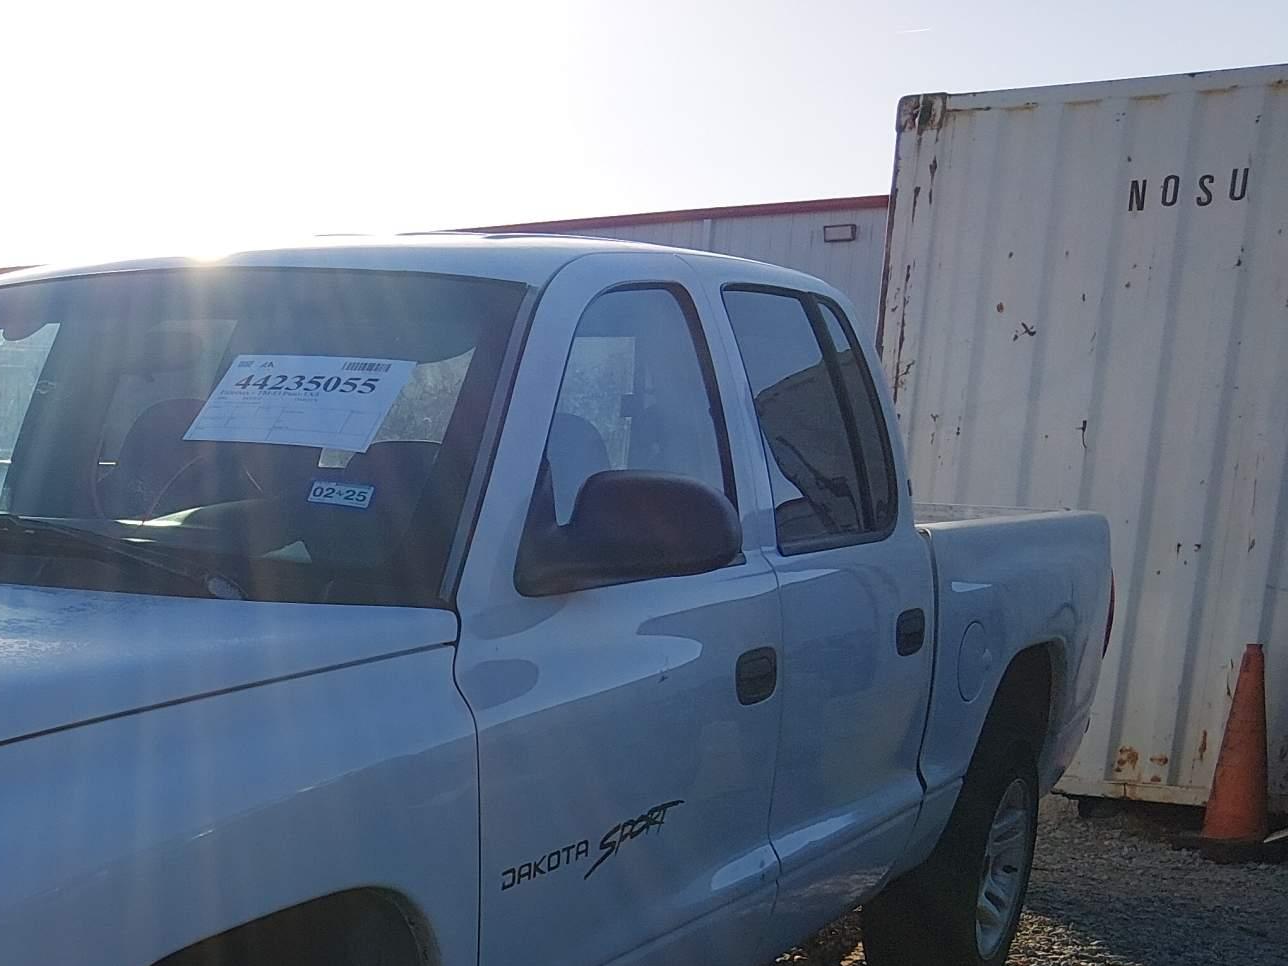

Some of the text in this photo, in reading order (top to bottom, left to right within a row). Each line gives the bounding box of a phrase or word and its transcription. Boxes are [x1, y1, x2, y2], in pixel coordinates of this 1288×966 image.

[1128, 167, 1250, 212] NOSU
[235, 374, 379, 394] 44235055
[501, 839, 590, 891] DAKOTA
